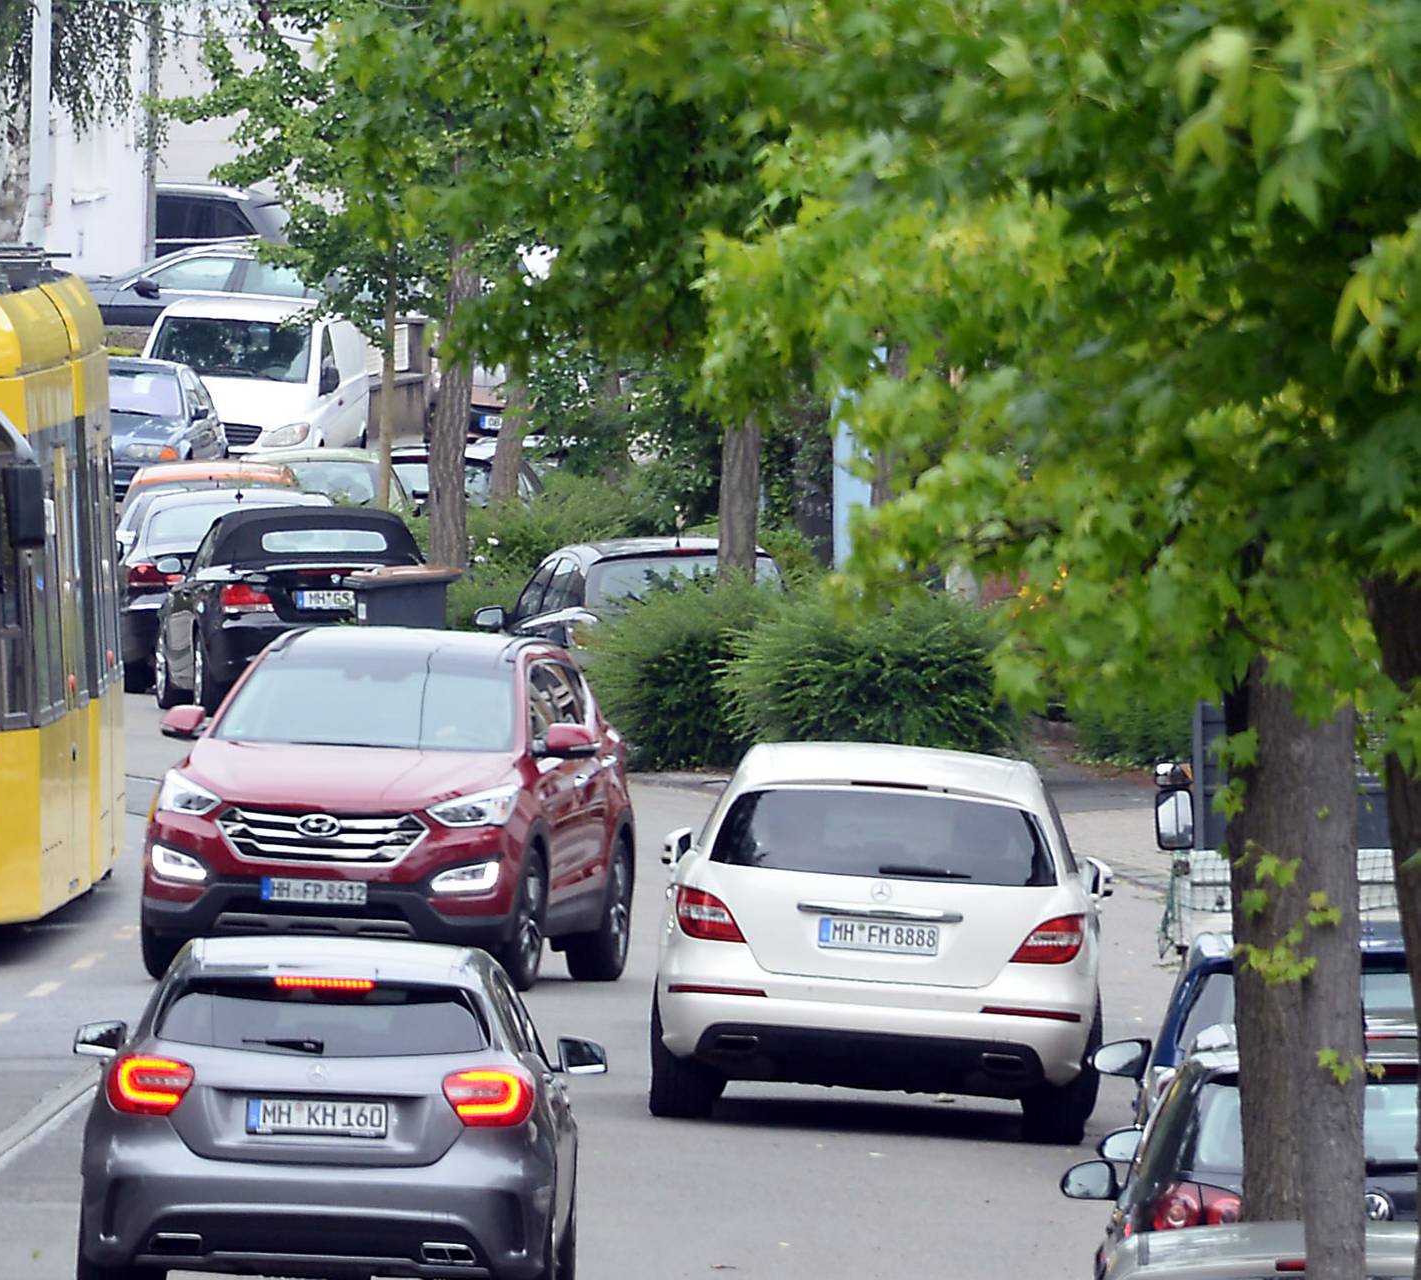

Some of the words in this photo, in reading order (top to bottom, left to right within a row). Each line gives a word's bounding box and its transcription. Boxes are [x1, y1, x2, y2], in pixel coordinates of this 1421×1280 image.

[309, 592, 326, 605] MH
[303, 882, 323, 900] FP
[832, 923, 854, 942] MH
[868, 925, 890, 944] FM
[894, 927, 936, 948] 8888
[262, 1101, 291, 1125] MH
[307, 1103, 336, 1126] KH
[341, 1105, 383, 1128] 160
